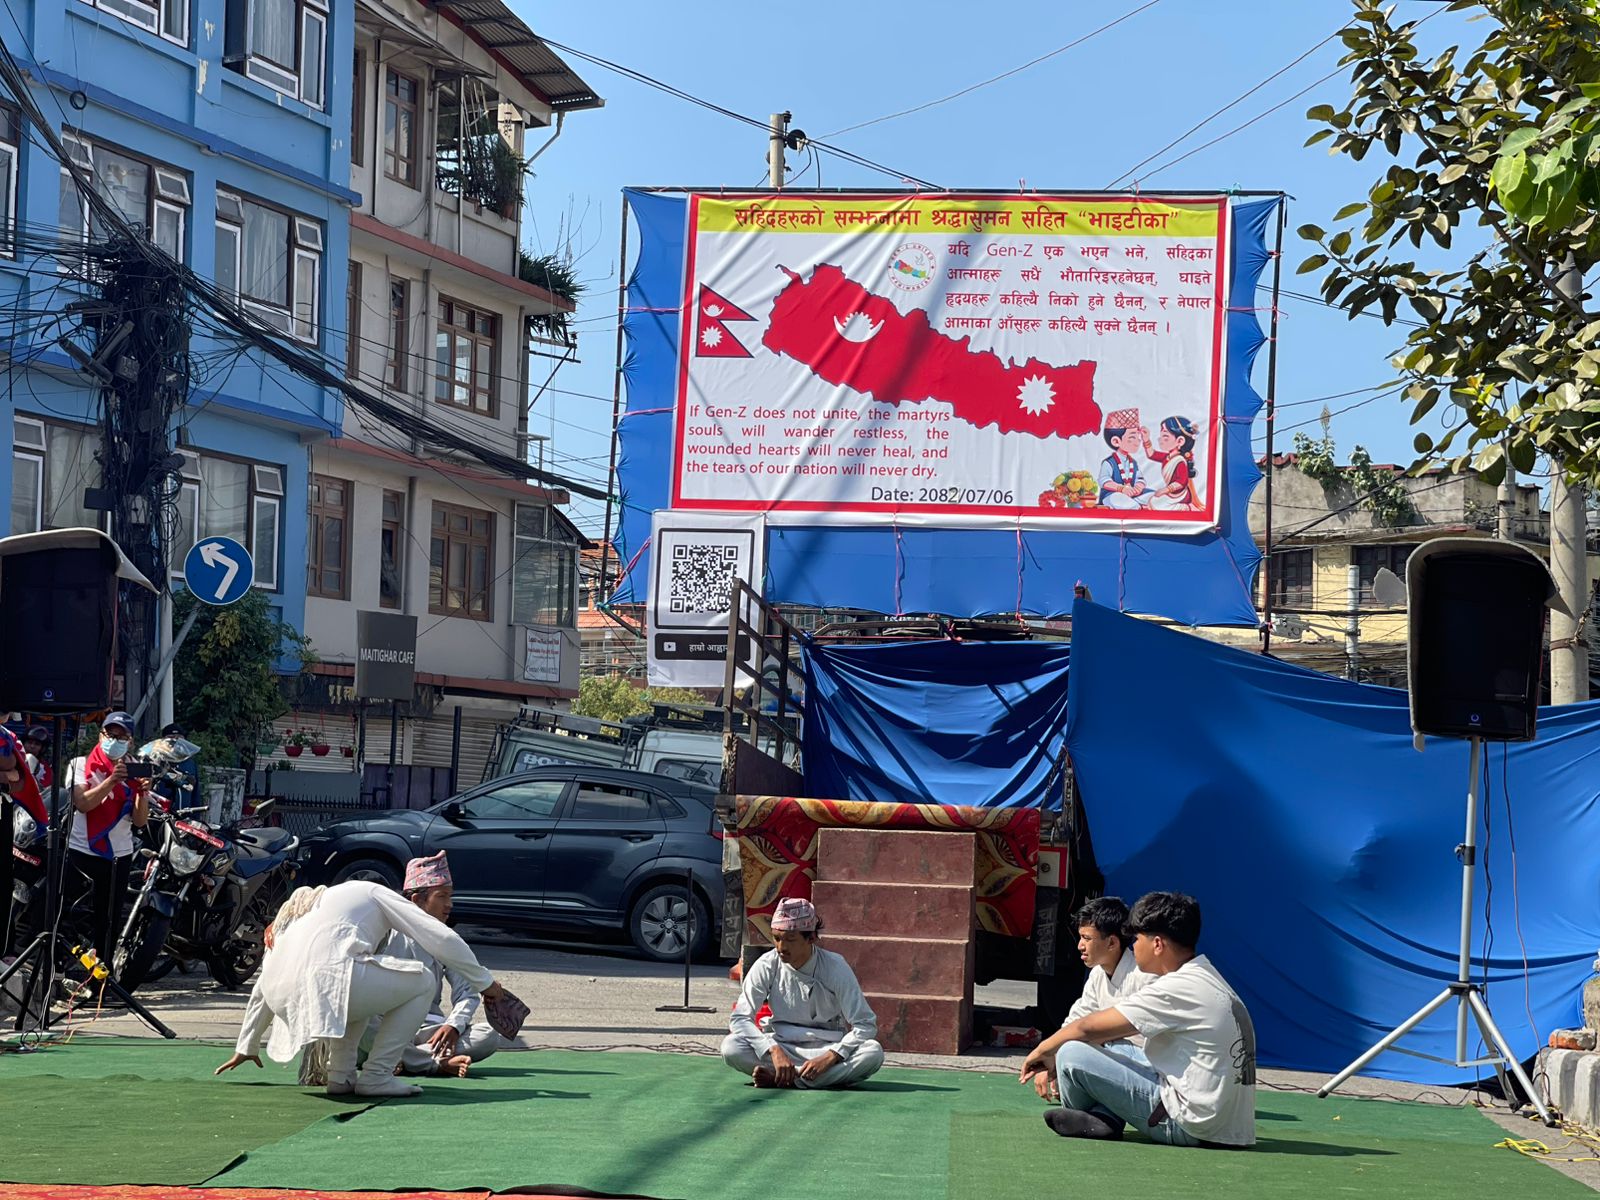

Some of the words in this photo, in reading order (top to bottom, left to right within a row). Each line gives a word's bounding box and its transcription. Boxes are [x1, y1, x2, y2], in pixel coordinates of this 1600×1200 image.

[834, 209, 922, 228] सम्झनामा
[930, 209, 1012, 233] श्रद्धासुमन
[1021, 204, 1069, 232] सहित
[948, 239, 971, 258] यदि
[986, 242, 1034, 258] Gen-Z
[1043, 245, 1065, 260] एक
[1080, 246, 1110, 261] भएन
[1166, 244, 1214, 262] सहिदका
[1179, 270, 1213, 286] घाइते
[999, 290, 1039, 307] कहिल्यै
[1048, 291, 1079, 307] निको
[1087, 293, 1105, 312] हुने
[1158, 296, 1168, 310] र
[1177, 294, 1212, 309] नेपाल
[944, 317, 992, 329] आमाका
[1048, 315, 1088, 333] कहिल्यै
[1094, 317, 1122, 336] सुक्ने
[1127, 316, 1158, 336] छैनन्
[688, 404, 700, 418] If
[704, 405, 748, 419] Gen-Z
[752, 406, 786, 420] does
[792, 408, 817, 420] not
[822, 408, 862, 422] unite,
[867, 408, 891, 421] the
[897, 409, 950, 423] martyrs
[688, 423, 724, 437] souls
[741, 424, 766, 437] will
[783, 426, 836, 439] wander
[853, 427, 909, 441] restless,
[926, 427, 950, 440] the
[687, 442, 752, 456] wounded
[758, 443, 801, 457] hearts
[807, 444, 832, 457] will
[837, 447, 877, 458] never
[882, 445, 917, 460] heal,
[921, 446, 949, 459] and
[686, 460, 709, 474] the
[712, 462, 746, 474] tears
[749, 461, 764, 474] of
[766, 464, 790, 475] our
[793, 462, 838, 475] nation
[841, 463, 866, 476] will
[870, 465, 909, 477] never
[911, 464, 938, 480] dry.
[871, 486, 915, 502] Date:
[918, 487, 1014, 505] 2082/07/06
[360, 647, 398, 663] MAITIGHAR
[398, 650, 414, 665] CAFE
[707, 644, 729, 654] आह्वा
